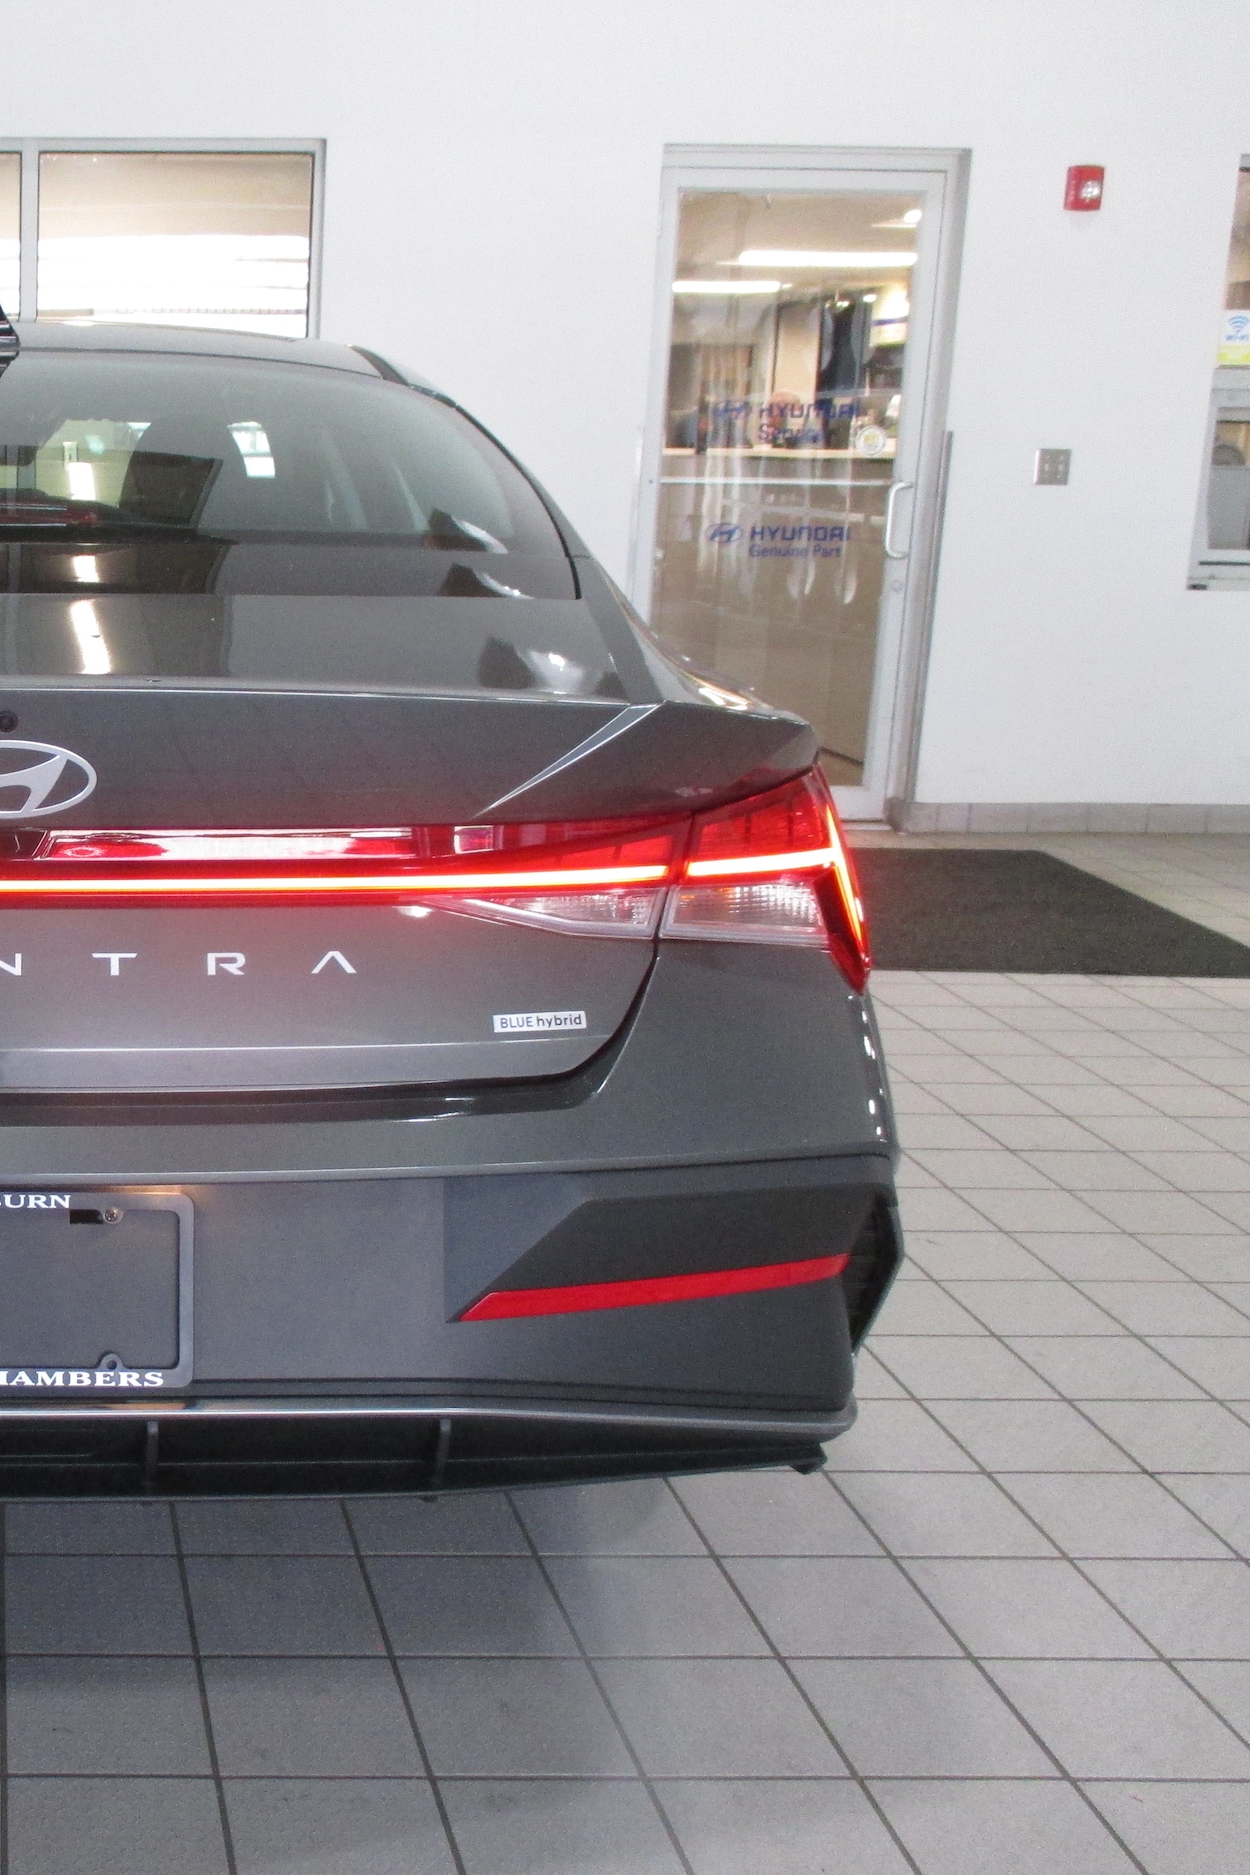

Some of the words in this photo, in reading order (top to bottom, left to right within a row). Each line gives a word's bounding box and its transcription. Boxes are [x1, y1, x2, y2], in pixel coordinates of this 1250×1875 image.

[750, 525, 851, 541] HYUNDAI
[499, 1017, 534, 1029] BLUE
[536, 1014, 582, 1028] hybrid
